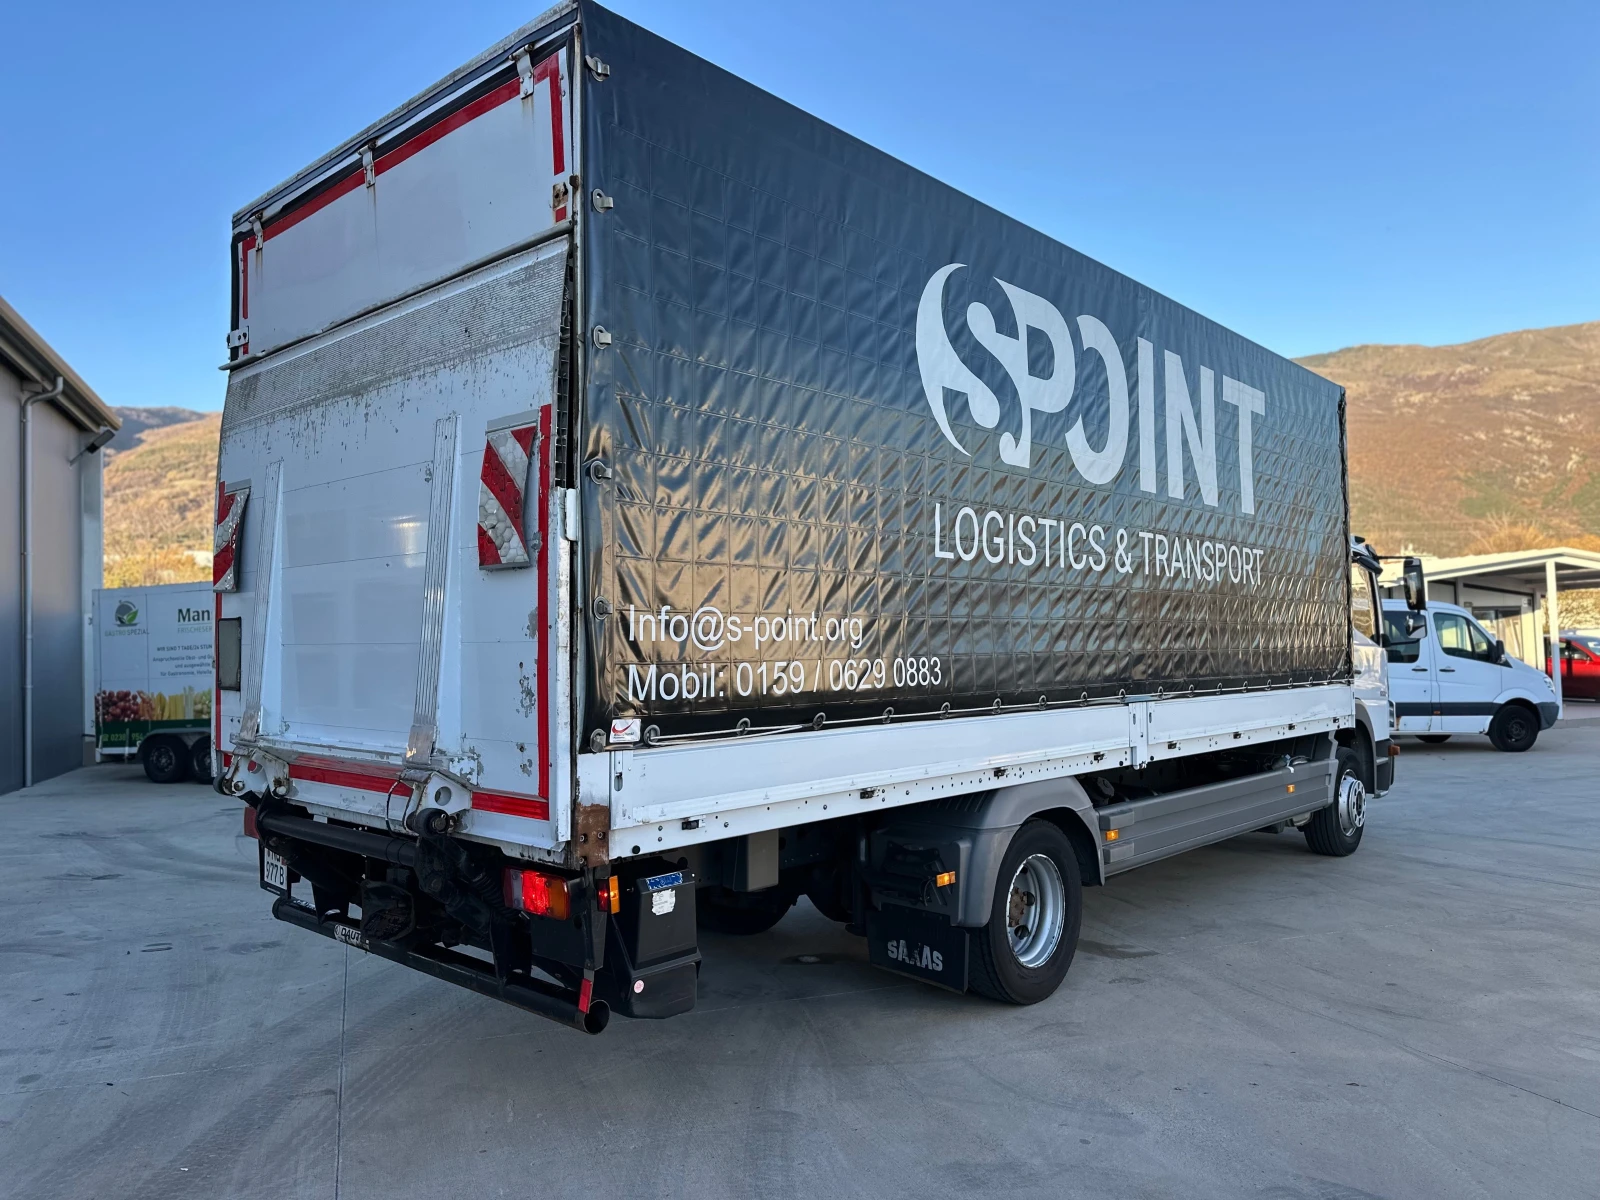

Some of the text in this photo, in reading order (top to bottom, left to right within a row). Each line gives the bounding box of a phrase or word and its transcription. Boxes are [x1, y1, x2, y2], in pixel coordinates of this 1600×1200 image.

[934, 502, 1264, 586] LOGISTICS & TRANSPORT
[628, 604, 863, 651] Info@s-point.org
[628, 656, 942, 701] Mobil: 0159 / 0629 0883
[266, 860, 285, 886] 977 B
